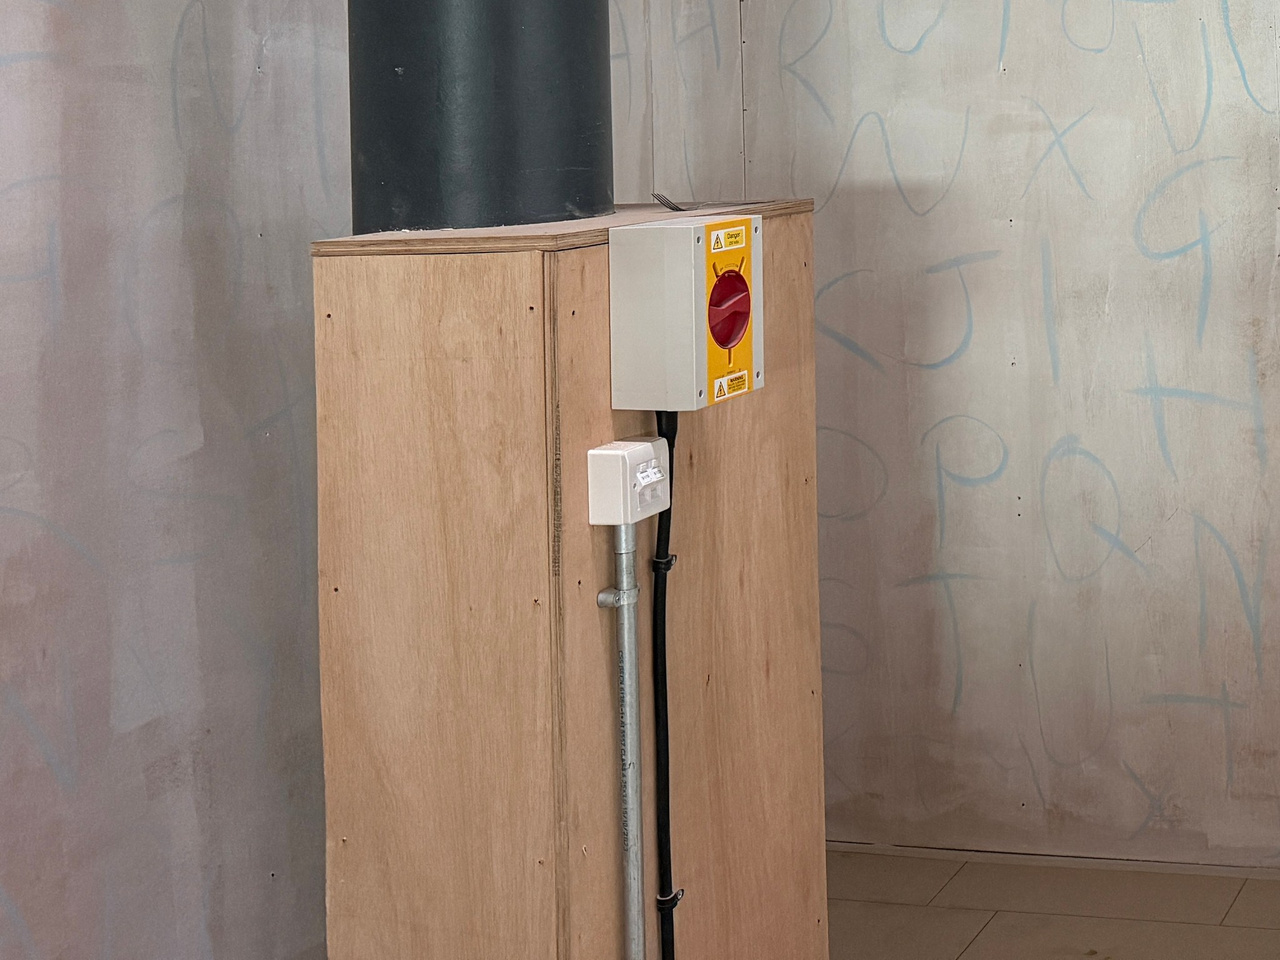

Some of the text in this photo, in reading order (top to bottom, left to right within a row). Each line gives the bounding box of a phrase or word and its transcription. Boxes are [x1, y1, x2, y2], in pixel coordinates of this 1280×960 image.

[1022, 100, 1098, 208] X
[898, 250, 1003, 371] J
[1133, 333, 1268, 478] H
[921, 414, 1010, 549] P
